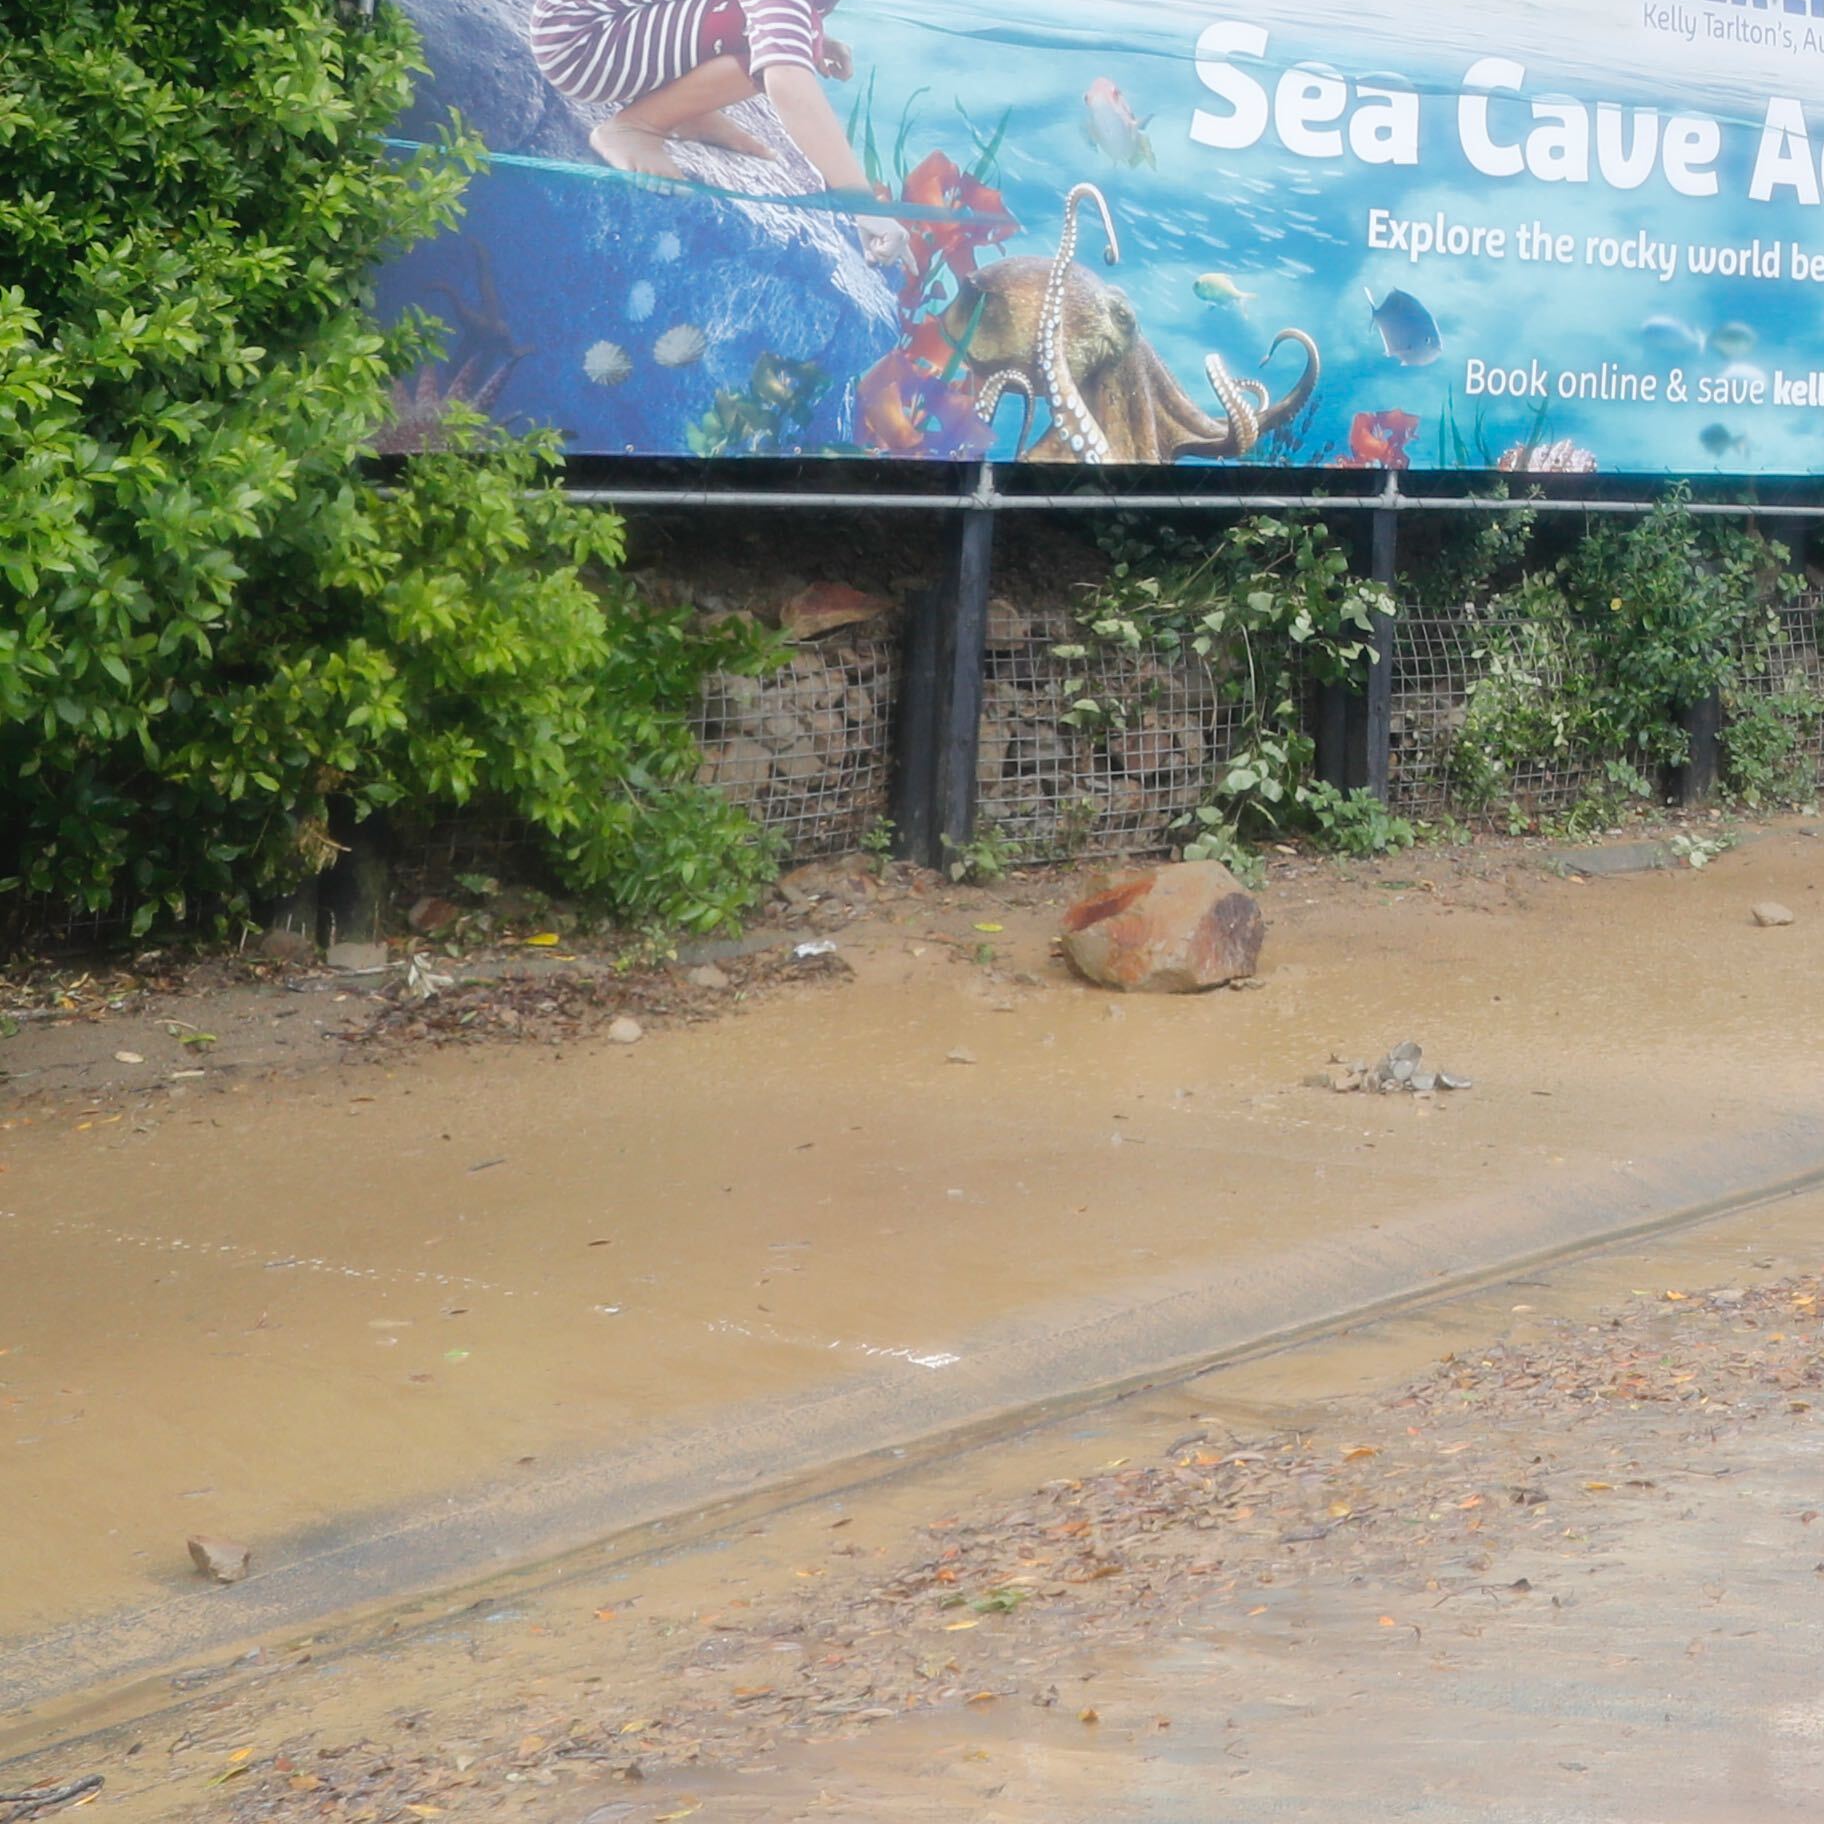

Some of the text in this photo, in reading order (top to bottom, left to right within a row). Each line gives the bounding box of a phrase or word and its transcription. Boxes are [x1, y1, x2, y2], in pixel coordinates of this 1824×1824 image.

[1643, 2, 1697, 42] Kelly
[1703, 11, 1798, 55] Tarlton's,
[1188, 20, 1420, 165] Sea
[1457, 56, 1722, 197] Cave
[1367, 208, 1506, 263] Explore
[1515, 221, 1575, 263] the
[1585, 230, 1677, 281] rocky
[1687, 239, 1781, 279] world
[1465, 358, 1549, 398] Book
[1557, 363, 1657, 402] online
[1665, 368, 1689, 403] &
[1697, 376, 1764, 404] save
